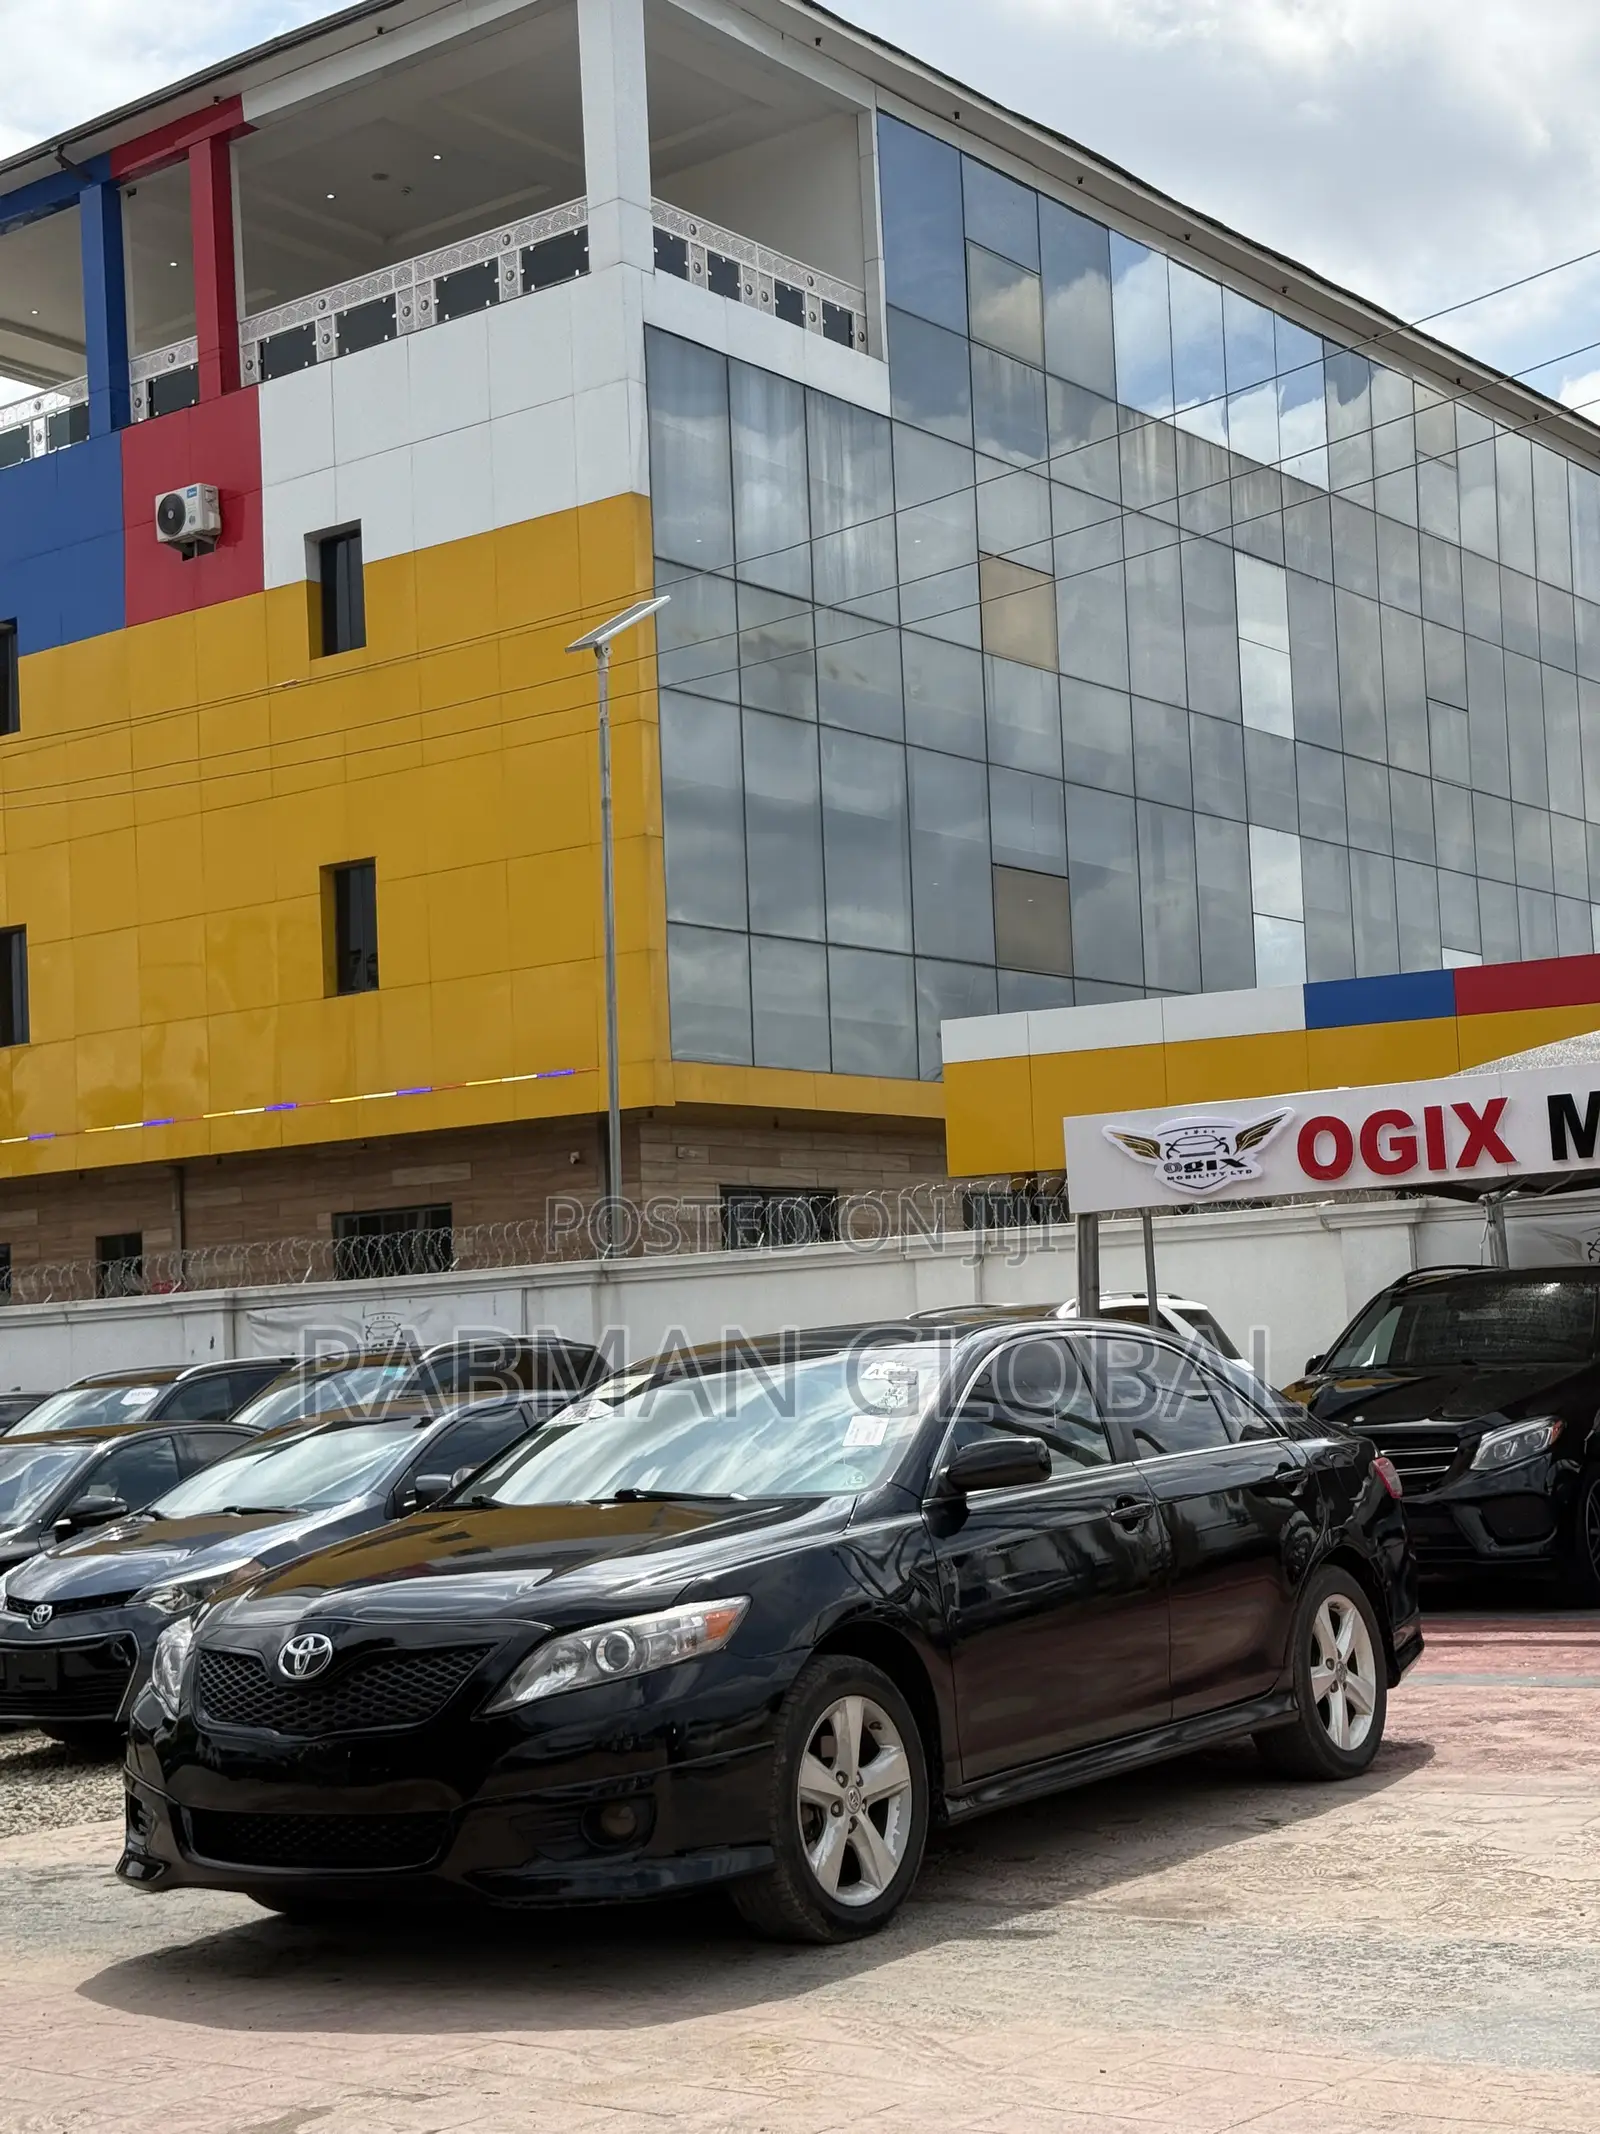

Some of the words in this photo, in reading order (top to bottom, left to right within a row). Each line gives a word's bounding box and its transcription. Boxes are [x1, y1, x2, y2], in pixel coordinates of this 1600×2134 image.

[1297, 1097, 1517, 1181] OGIX
[1166, 1170, 1227, 1181] MOBILITY
[1230, 1168, 1253, 1177] LTD
